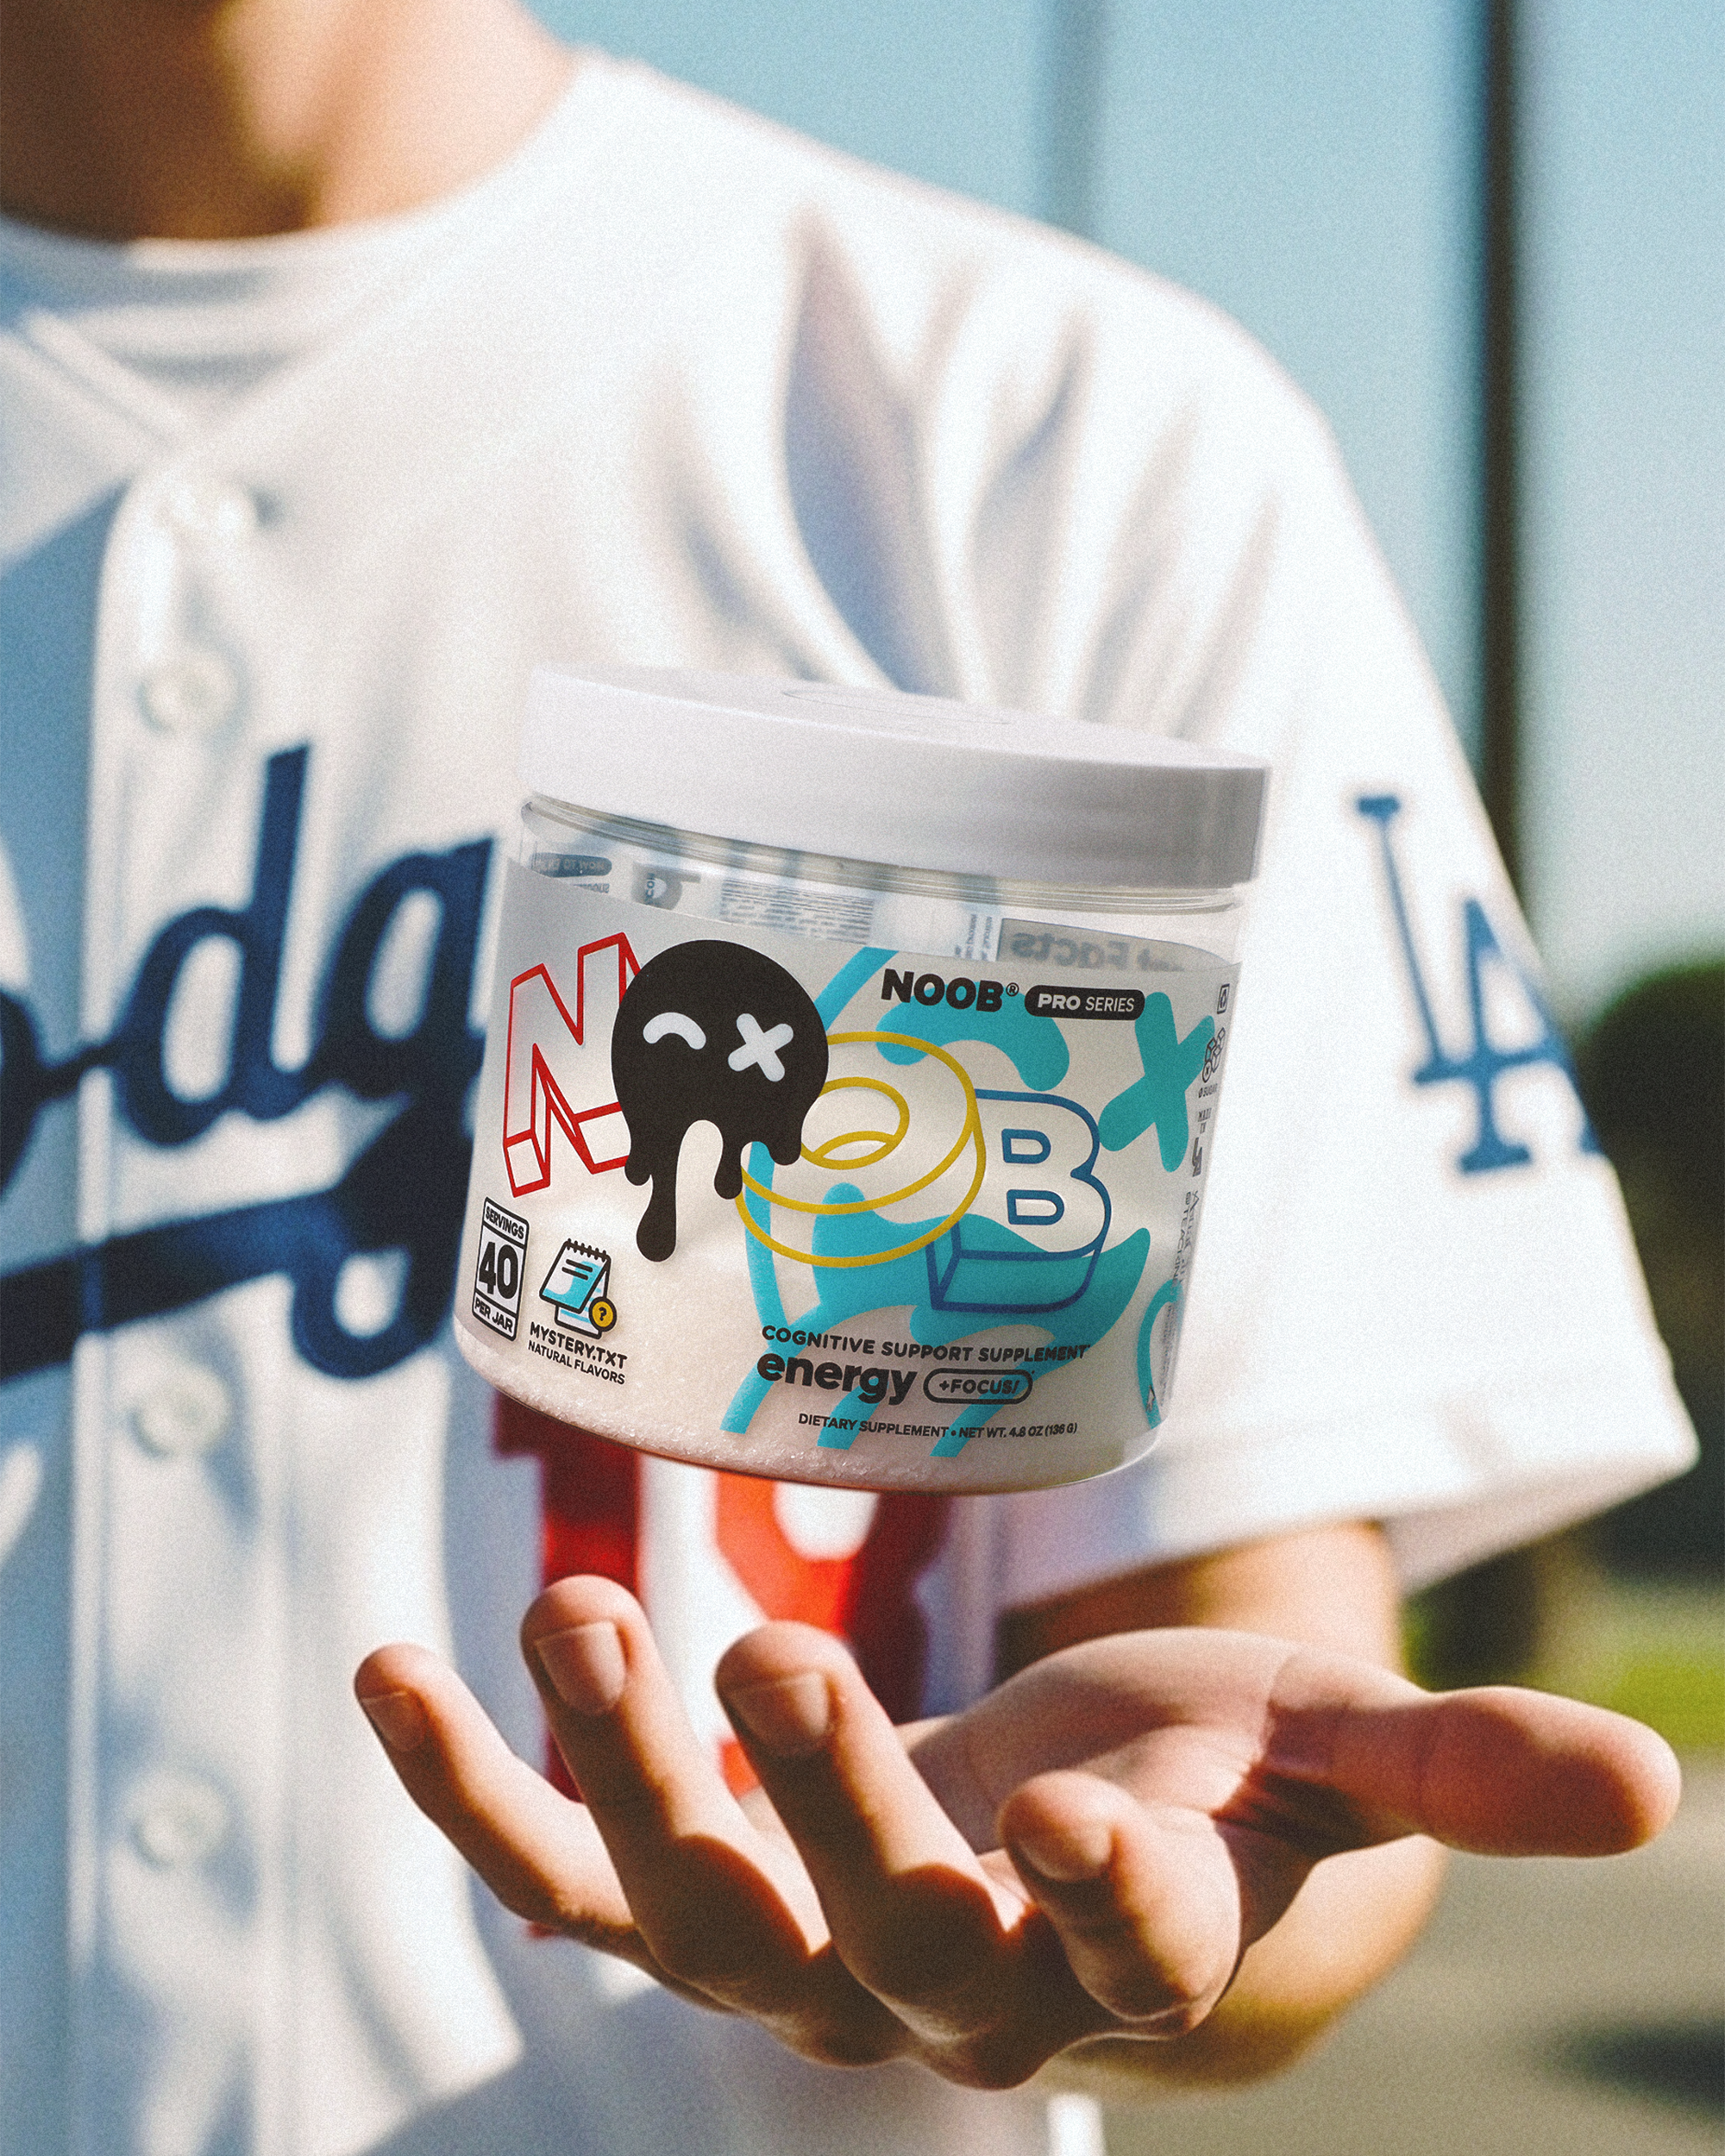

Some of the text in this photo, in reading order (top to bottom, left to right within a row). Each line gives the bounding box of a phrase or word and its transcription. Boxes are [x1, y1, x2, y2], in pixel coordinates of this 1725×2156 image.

[1038, 993, 1135, 1012] PRO SERIES
[486, 1206, 524, 1240] SERVINGS
[479, 1241, 518, 1300] 40
[474, 1298, 513, 1333] PER JAR
[530, 1322, 627, 1369] MYSTERY.TXT
[762, 1326, 875, 1355] COGNITIVE
[881, 1342, 975, 1362] SUPPORT
[528, 1340, 625, 1385] NATURAL FLAVORS
[756, 1353, 918, 1406] energy
[799, 1413, 858, 1432] DIETARY
[859, 1420, 948, 1438] SUPPLEMENT
[958, 1426, 985, 1438] NET
[986, 1426, 1007, 1438] WT.
[1008, 1426, 1026, 1438] 4.8
[1028, 1426, 1044, 1438] OZ
